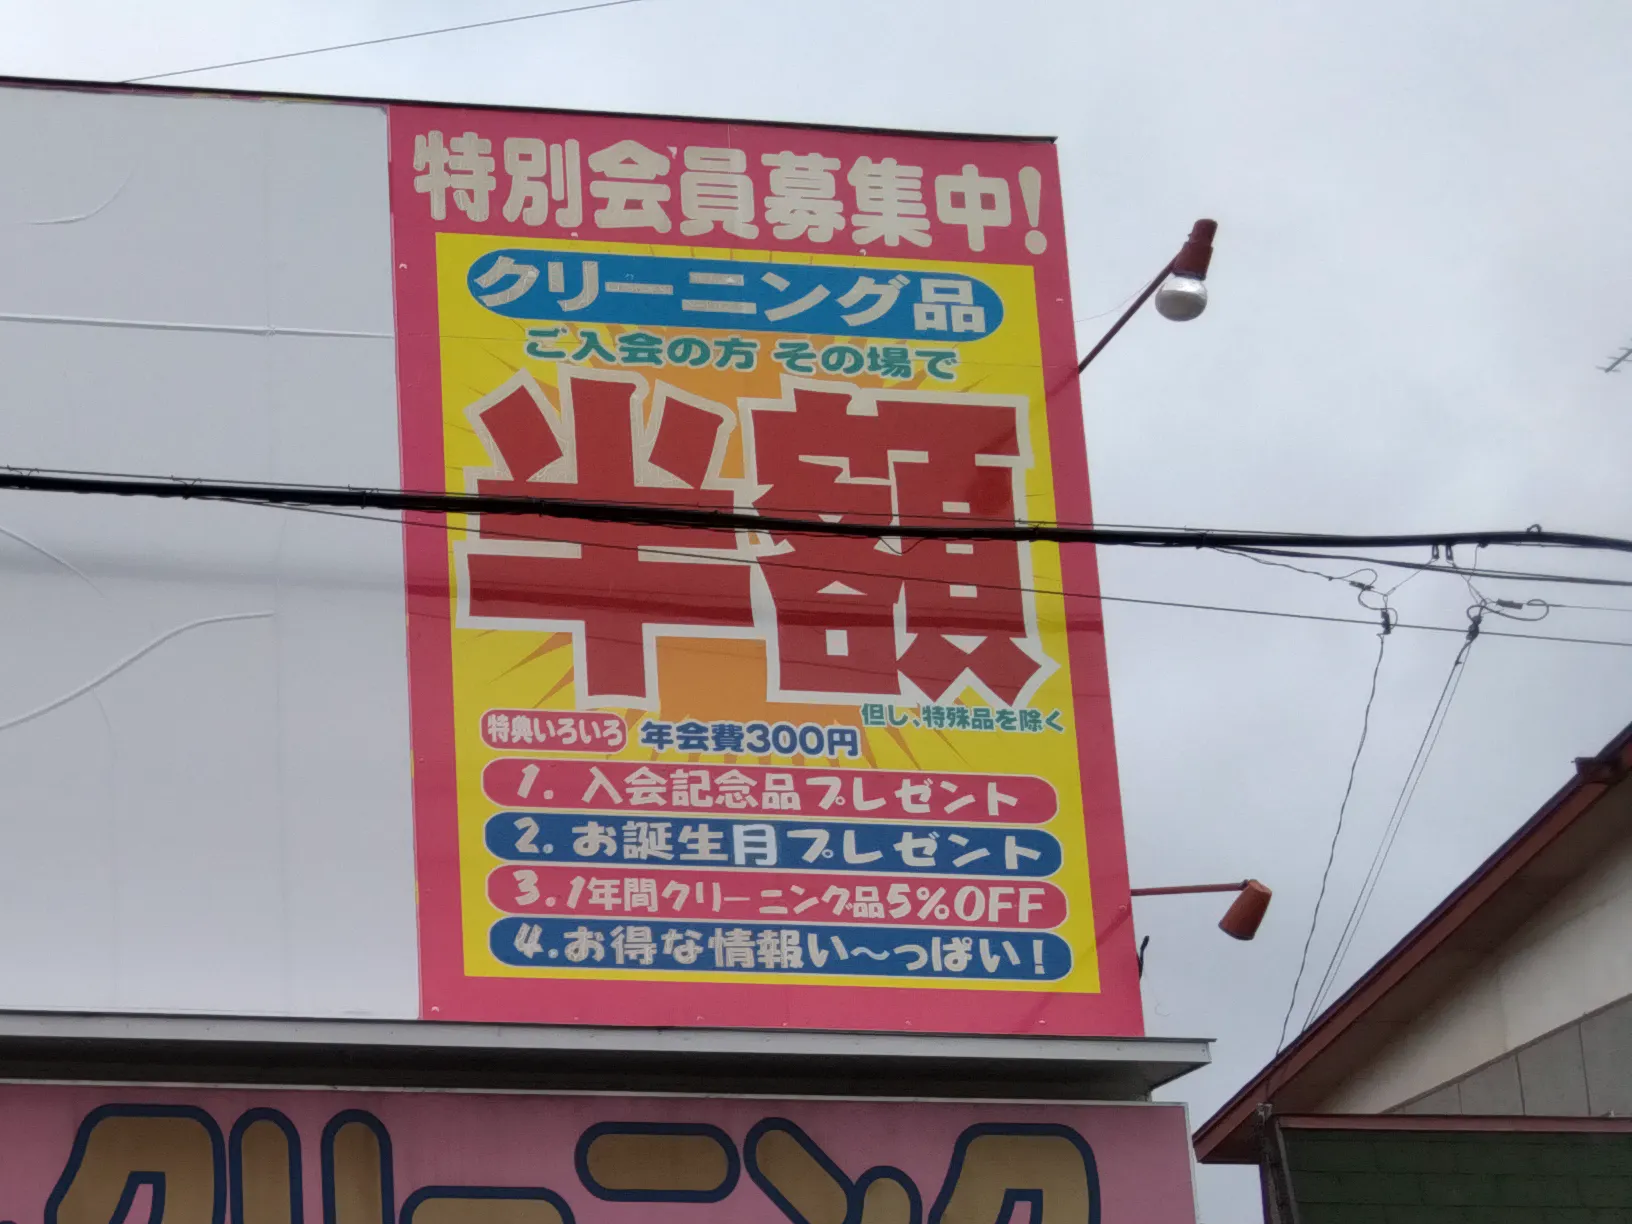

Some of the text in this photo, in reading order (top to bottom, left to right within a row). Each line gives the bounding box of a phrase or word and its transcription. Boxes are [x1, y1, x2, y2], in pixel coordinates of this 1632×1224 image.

[474, 255, 987, 334] クリーニング品
[523, 326, 959, 381] ご入会の方 その場で
[458, 365, 1058, 708] 半額
[487, 714, 623, 746] 特典いろいろ
[640, 719, 860, 758] 年会費300円
